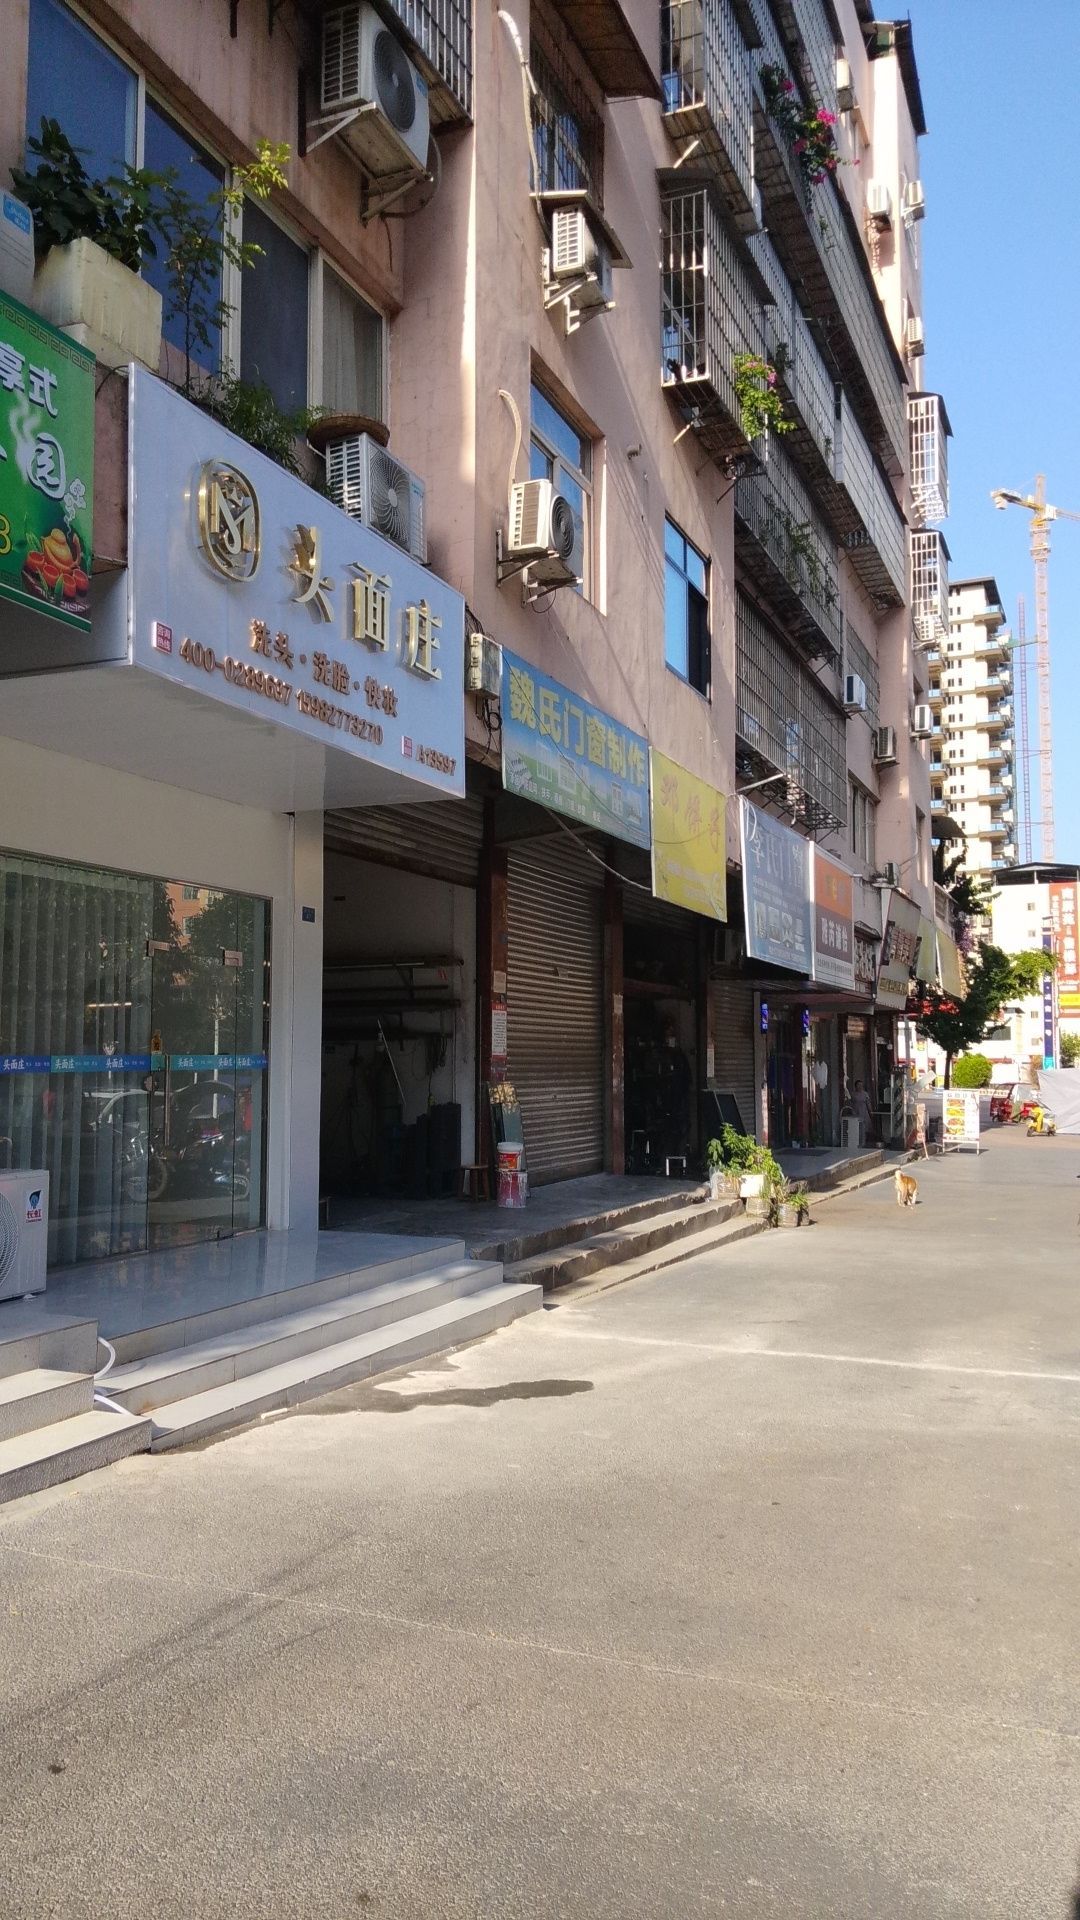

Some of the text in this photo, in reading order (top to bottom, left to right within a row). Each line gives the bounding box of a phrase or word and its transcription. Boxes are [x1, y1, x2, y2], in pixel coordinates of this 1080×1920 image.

[288, 524, 443, 681] 头面庄
[509, 666, 646, 786] 魏氏门窗制作
[3, 1058, 25, 1070] 头面庄
[55, 1058, 75, 1069] 头面庄
